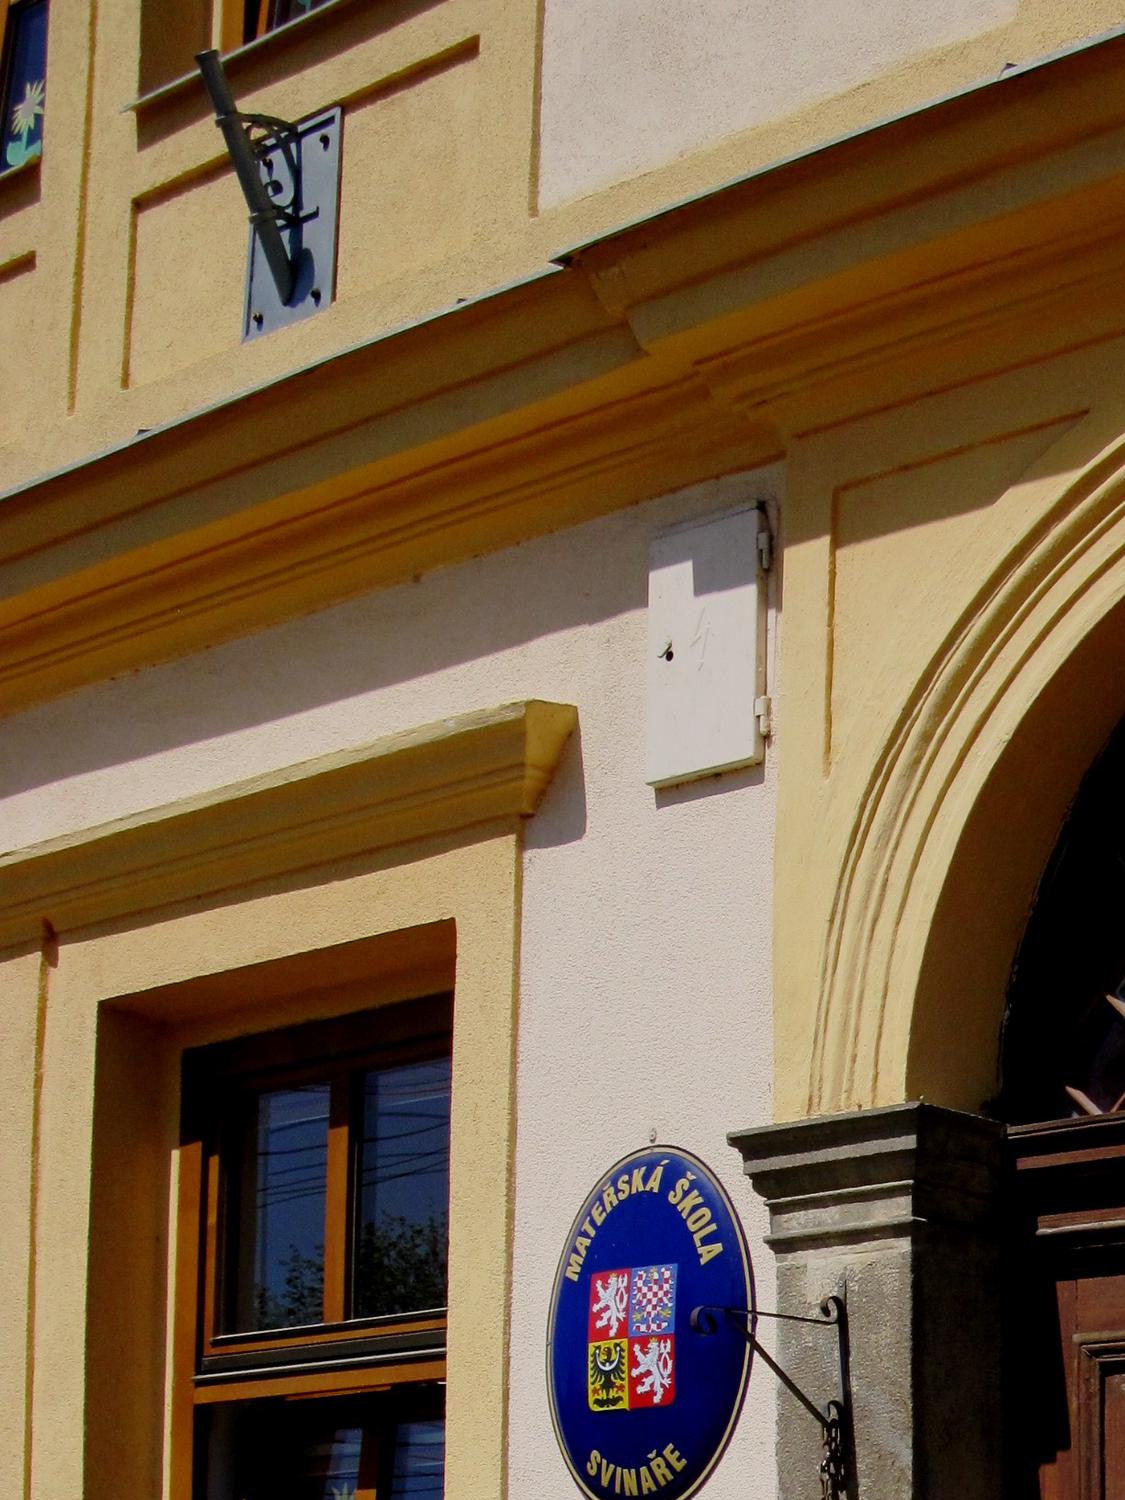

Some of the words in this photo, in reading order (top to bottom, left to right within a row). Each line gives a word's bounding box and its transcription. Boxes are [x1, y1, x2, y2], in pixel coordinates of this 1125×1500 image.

[565, 1160, 670, 1282] MATEŘSKÁ
[668, 1171, 724, 1266] ŠKOLA
[586, 1443, 687, 1496] SVINAŘE
